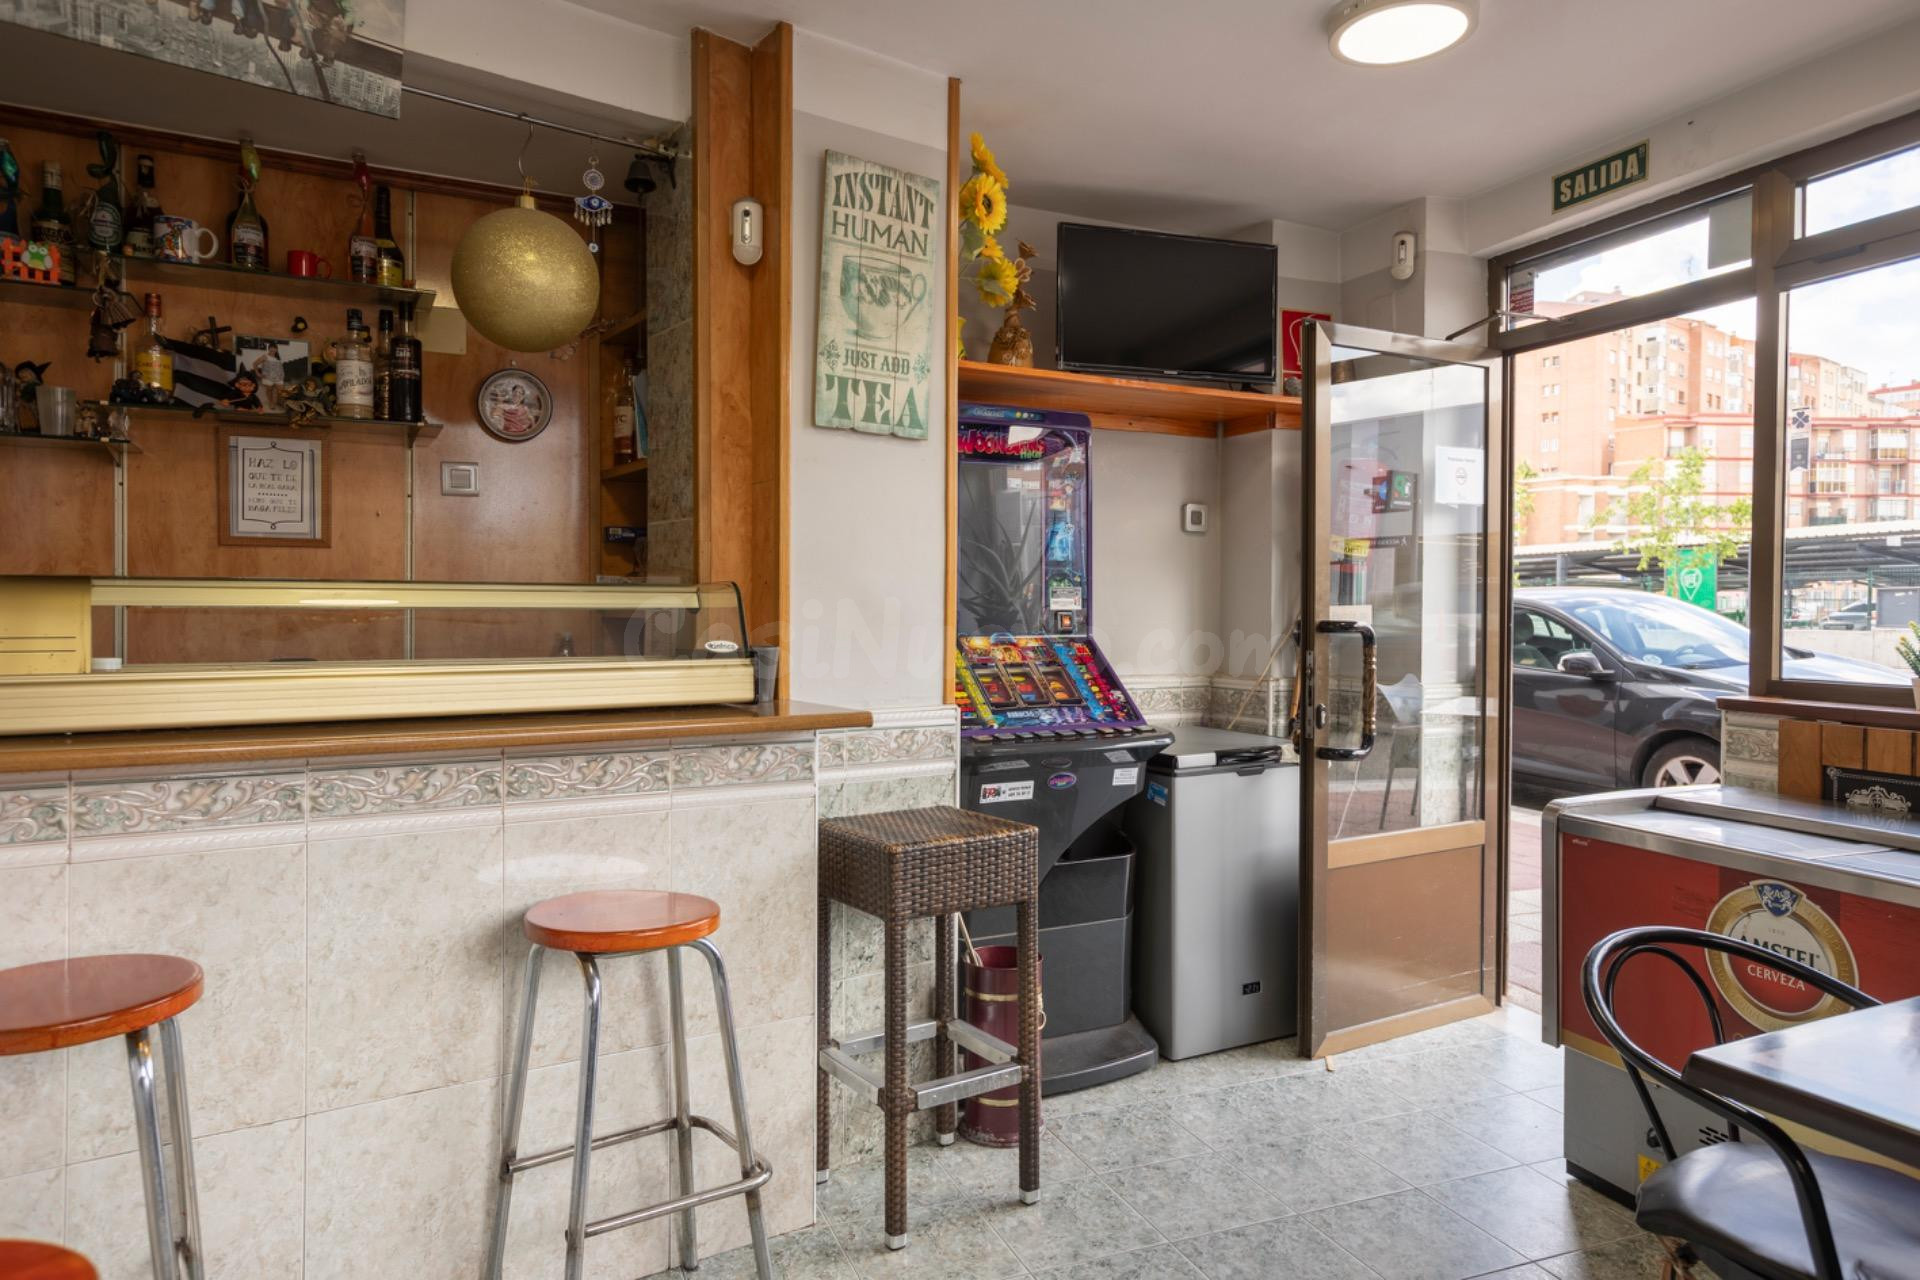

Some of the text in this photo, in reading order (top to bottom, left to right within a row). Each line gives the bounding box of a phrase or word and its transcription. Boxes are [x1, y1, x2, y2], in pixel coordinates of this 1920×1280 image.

[832, 172, 934, 230] INSTANT
[1560, 153, 1639, 203] SALIDA
[832, 210, 928, 257] HUMAN
[842, 347, 910, 375] JUST ADD
[825, 374, 924, 430] TEA
[248, 457, 298, 470] HAZ LO
[1747, 964, 1806, 991] CERVEZA
